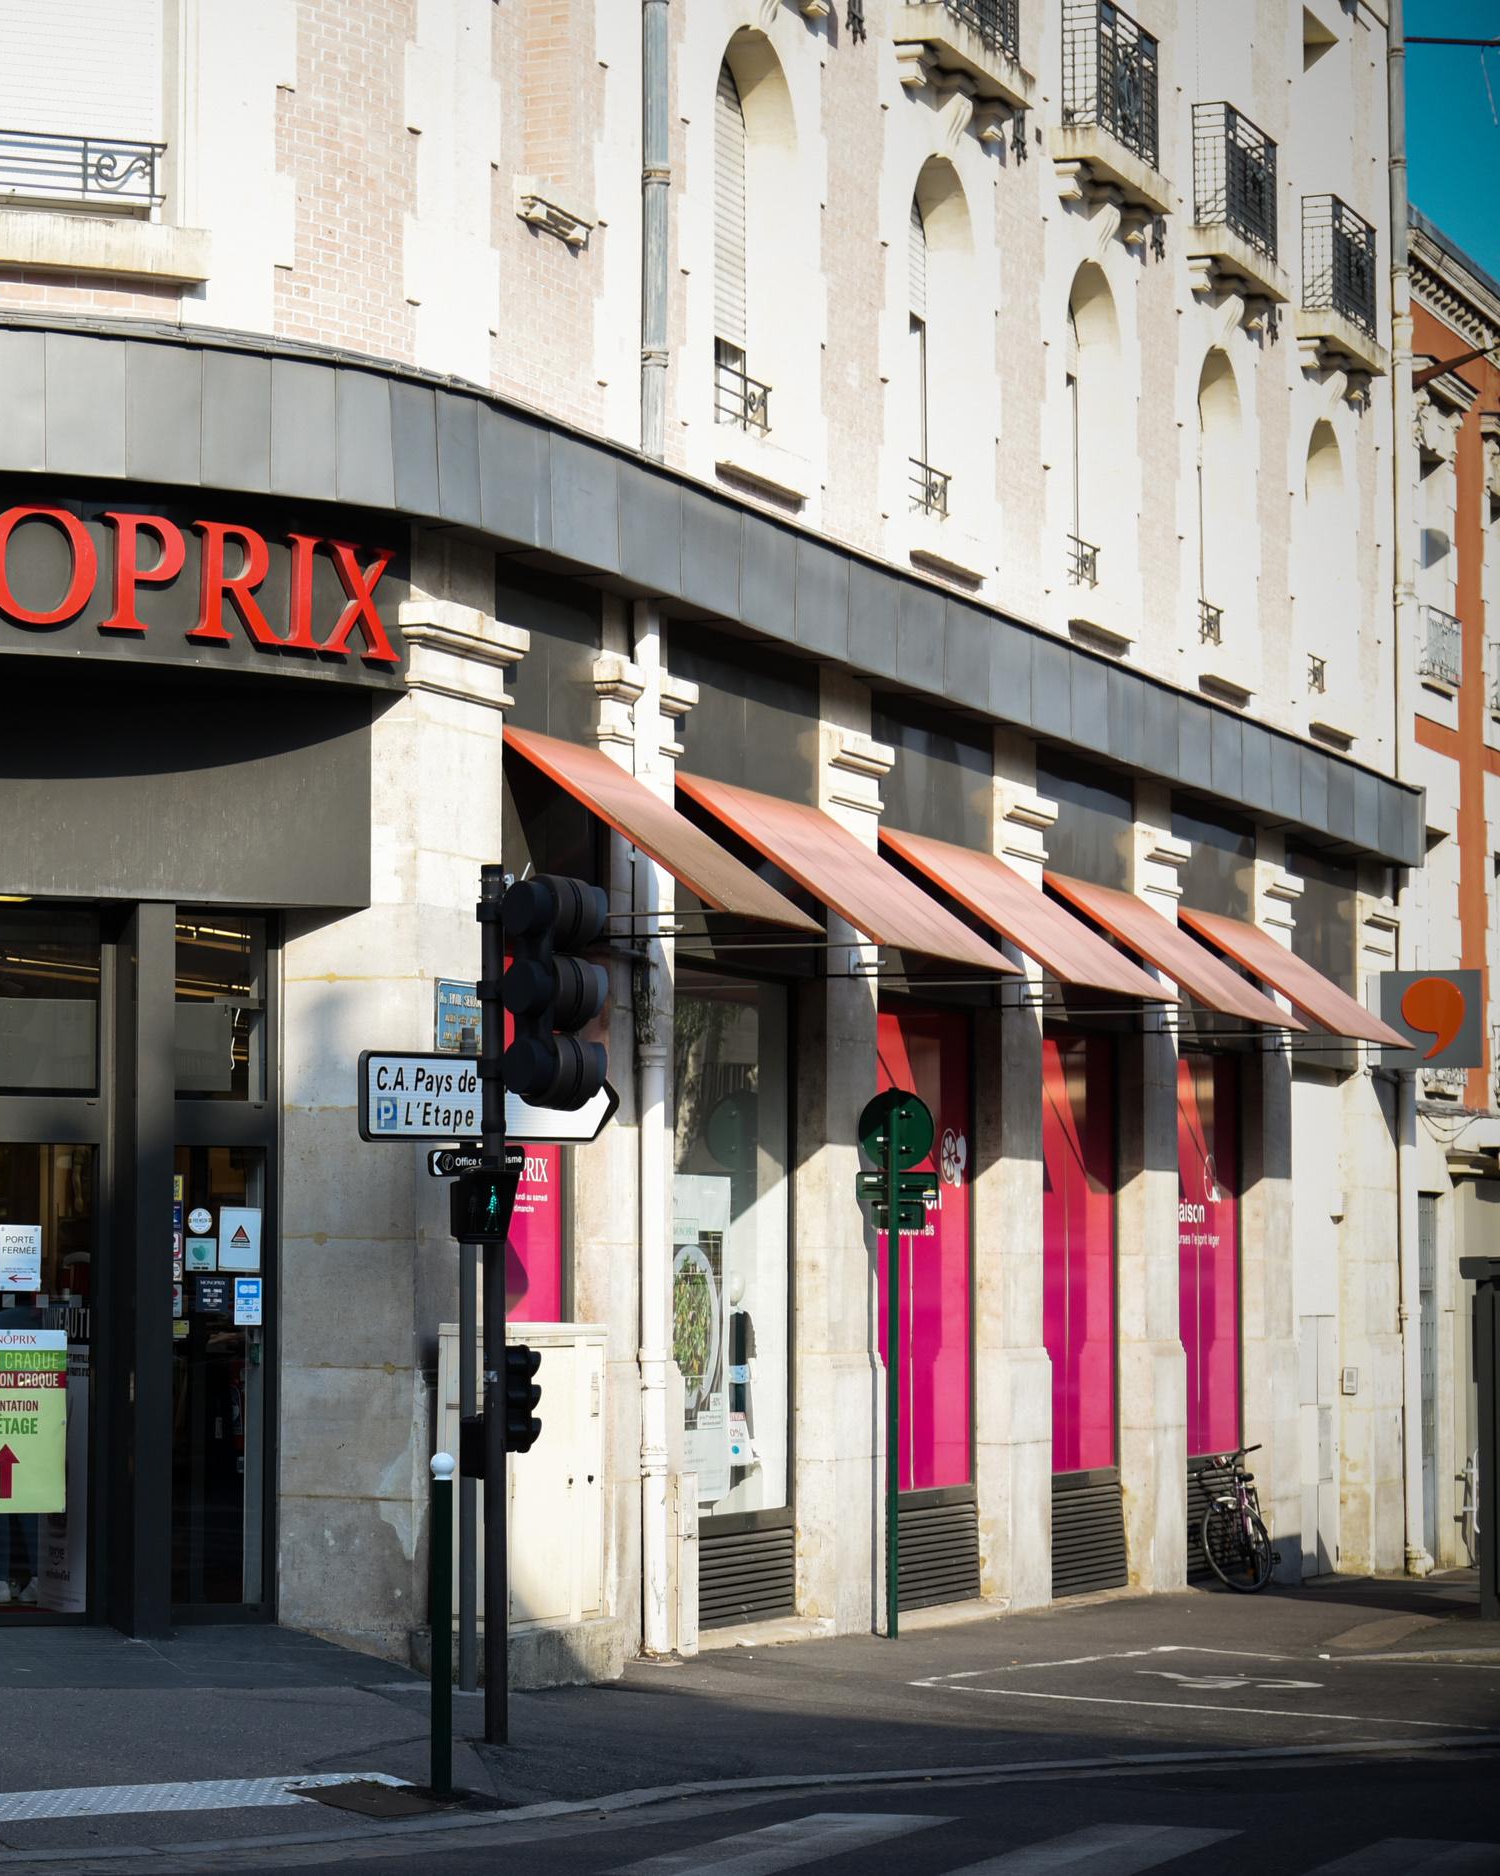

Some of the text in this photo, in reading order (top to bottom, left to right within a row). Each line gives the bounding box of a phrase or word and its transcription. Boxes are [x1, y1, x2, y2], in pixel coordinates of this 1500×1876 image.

[377, 1066, 477, 1098] C.A. Pays de
[380, 1100, 474, 1133] P L'Etape
[455, 1157, 477, 1166] Office
[1179, 1198, 1205, 1223] aison
[5, 1236, 34, 1244] PORTE
[4, 1352, 60, 1371] CRAQUE
[0, 1373, 14, 1387] ON
[17, 1373, 59, 1388] CROQUE
